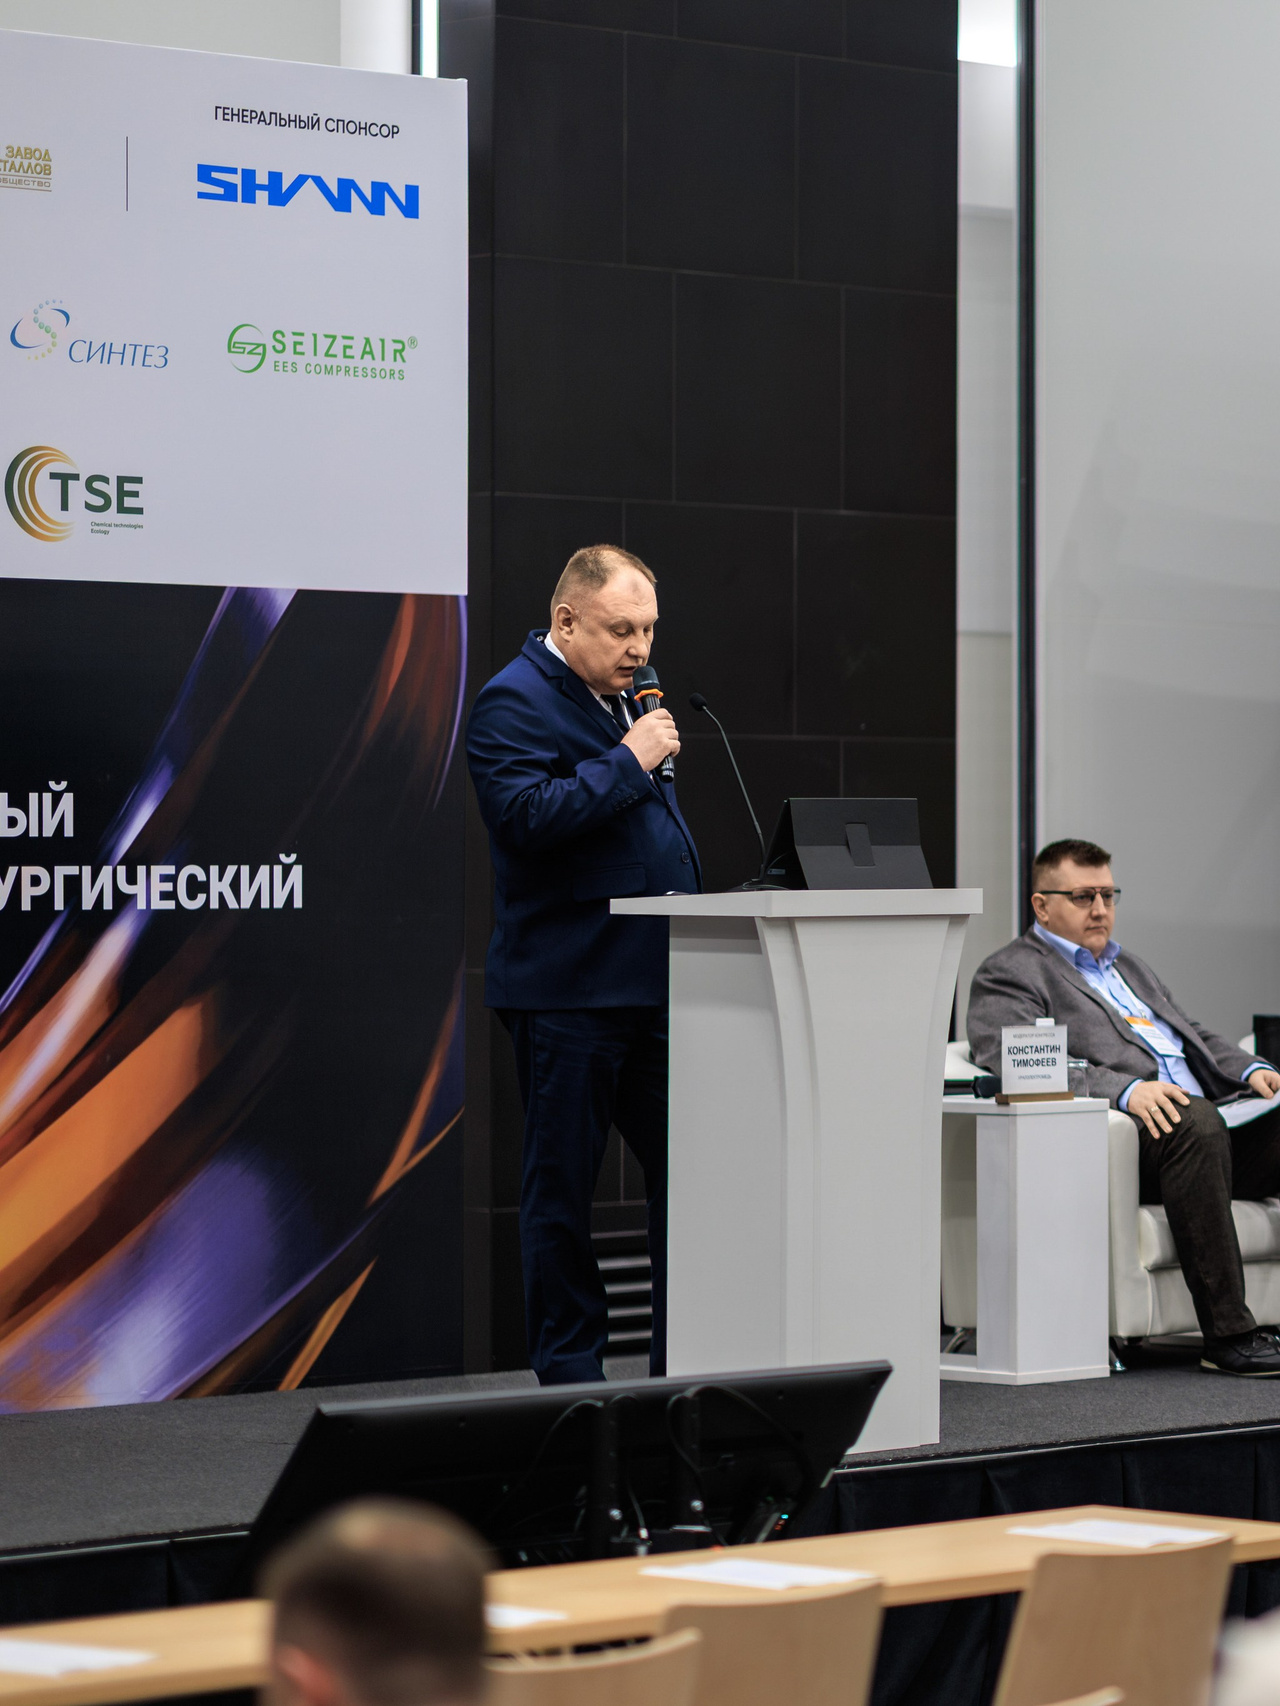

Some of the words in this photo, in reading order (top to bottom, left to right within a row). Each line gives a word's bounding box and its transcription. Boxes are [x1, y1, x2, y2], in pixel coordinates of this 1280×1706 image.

[214, 105, 321, 132] ГЕНЕРАЛЬНЫЙ
[324, 117, 401, 139] СПОНСОР
[5, 144, 52, 162] ЗАВОД
[0, 159, 52, 176] ТАЛЛОВ
[0, 177, 51, 188] БЩЕСТВО
[68, 338, 169, 369] СИНТЕЗ
[273, 360, 298, 374] EES
[304, 362, 406, 381] COMPRESSORS
[48, 471, 144, 515] TSE
[90, 528, 110, 536] Ecology
[113, 523, 144, 531] technologies
[0, 780, 74, 838] ЫЙ
[0, 853, 303, 911] УРГИЧЕСКИЙ
[1007, 1044, 1061, 1056] КОНСТАНТИН
[1011, 1057, 1057, 1068] ТИМОФЕЕВ
